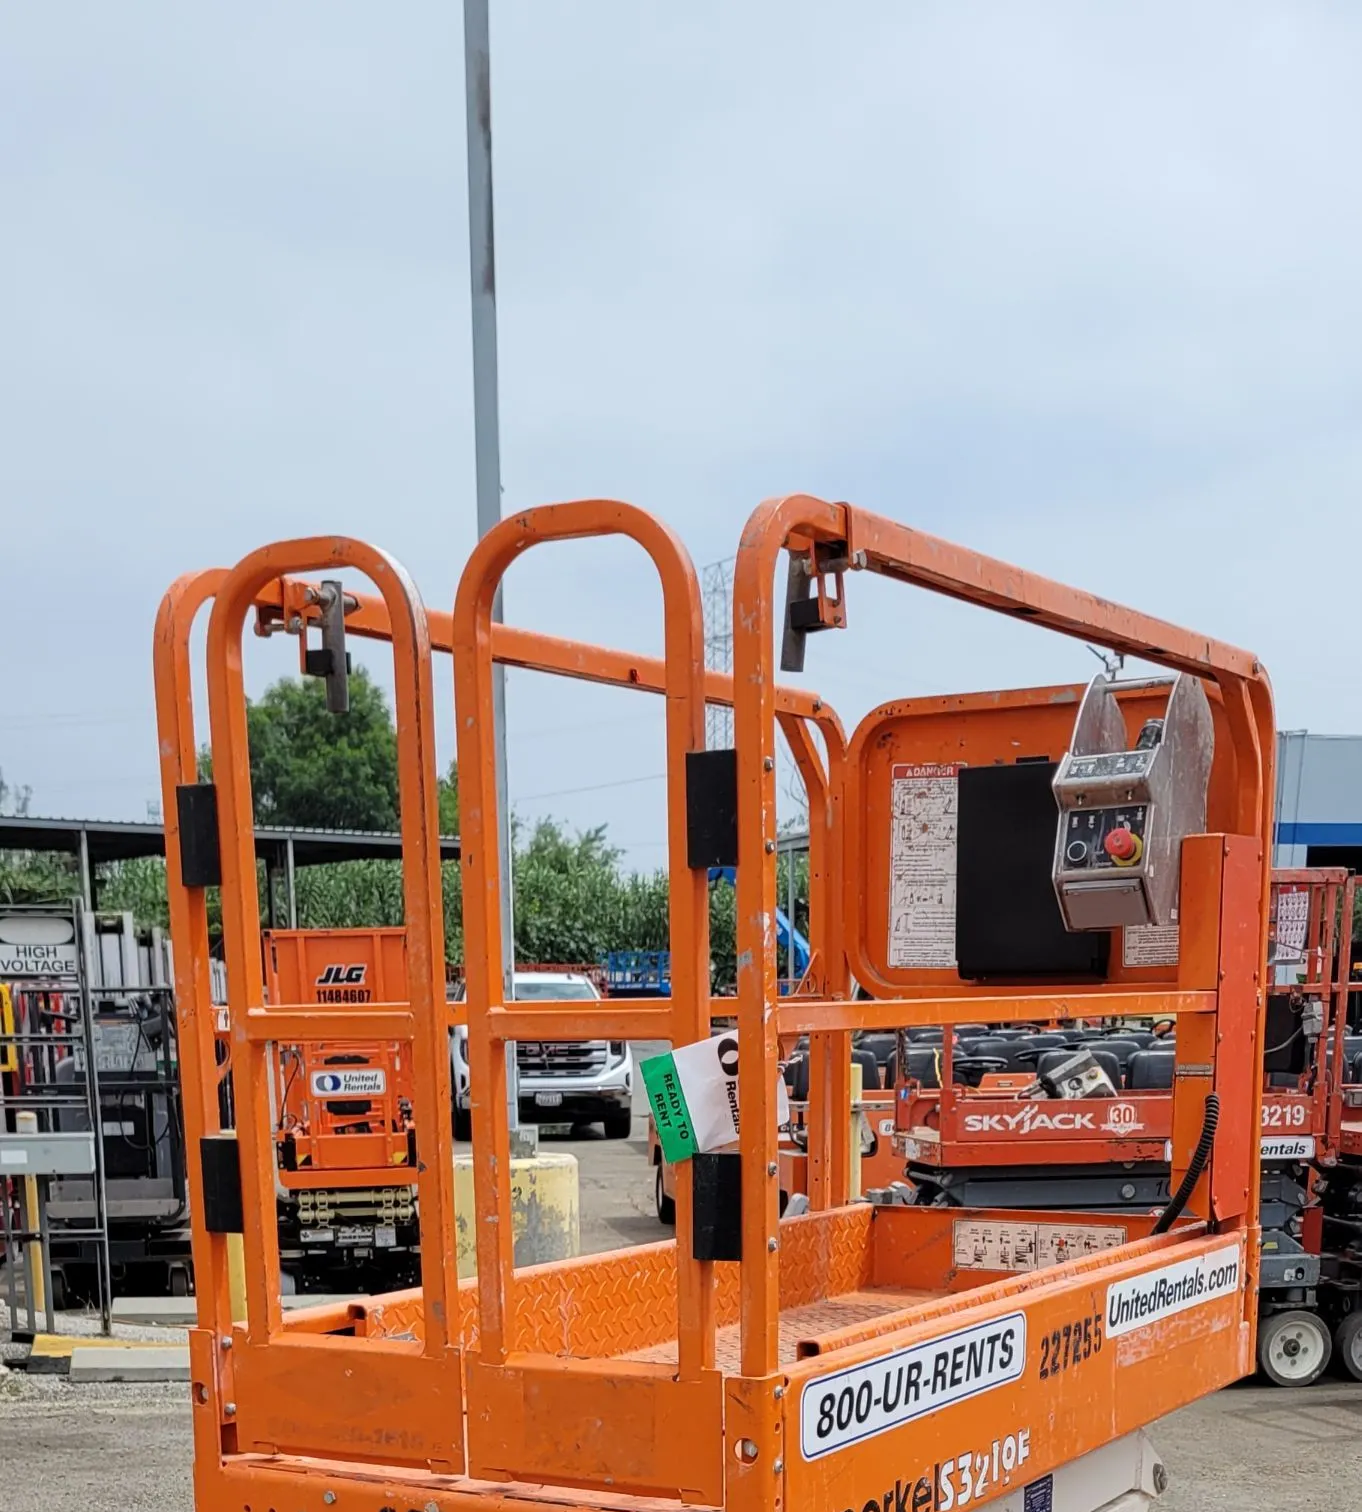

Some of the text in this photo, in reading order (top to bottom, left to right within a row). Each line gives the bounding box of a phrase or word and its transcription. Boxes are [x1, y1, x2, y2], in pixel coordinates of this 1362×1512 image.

[15, 945, 57, 959] HIGH
[0, 959, 76, 973] VOLTAGE
[317, 966, 365, 985] JLG
[316, 989, 372, 1004] 11484607
[343, 1073, 378, 1083] United
[343, 1083, 381, 1092] Rentals
[654, 1093, 673, 1128] RENT
[663, 1073, 690, 1140] READY TO
[1112, 1107, 1133, 1124] 30
[964, 1104, 1097, 1135] SKYJACK
[1260, 1141, 1307, 1156] entals
[1108, 1261, 1238, 1328] UnitedRentals.com
[1039, 1314, 1103, 1380] 227255
[816, 1328, 1015, 1439] 800-UR-RENTS
